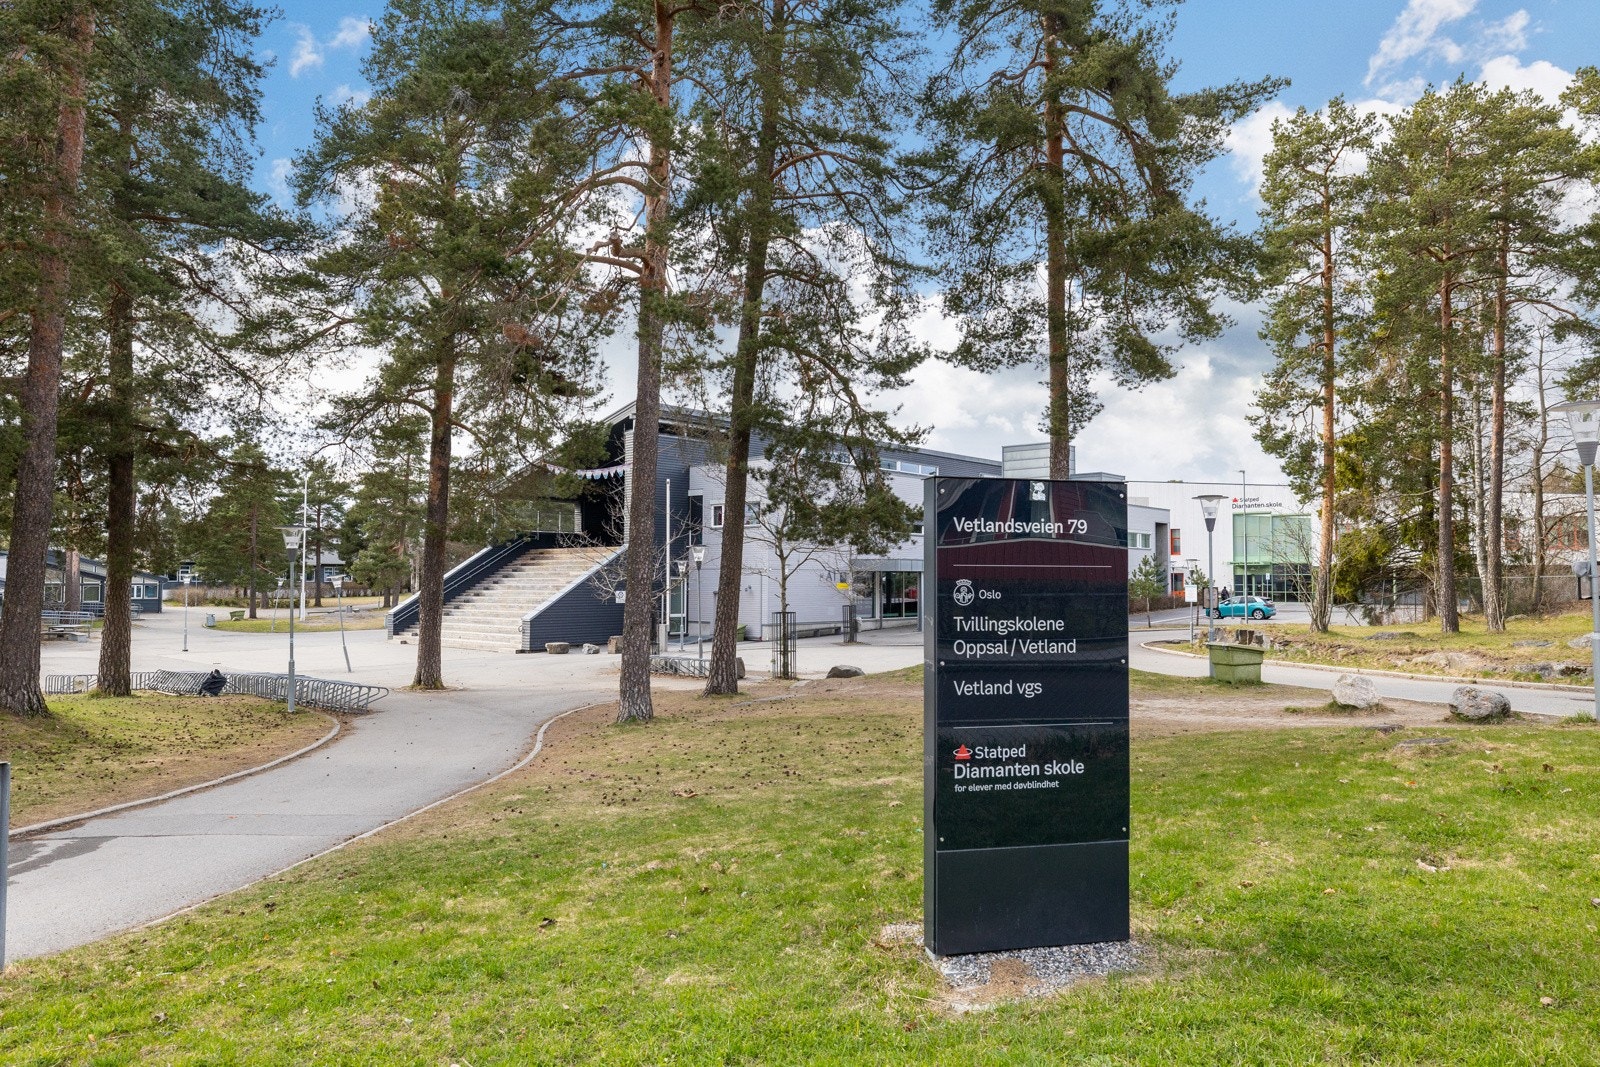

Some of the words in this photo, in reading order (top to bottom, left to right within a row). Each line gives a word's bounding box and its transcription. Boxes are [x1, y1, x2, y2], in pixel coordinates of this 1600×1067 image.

[953, 516, 1063, 534] Vetlandsveien
[1067, 519, 1088, 534] 79
[978, 590, 1002, 600] Oslo
[953, 616, 1065, 635] Tvillingskolene
[953, 639, 1009, 658] Oppsal
[1018, 638, 1077, 654] Vetland
[953, 680, 1013, 696] Vetland
[1016, 682, 1043, 698] vgs
[974, 744, 1026, 761] Statped
[954, 762, 1040, 779] Diamanten
[1044, 760, 1085, 775] skole
[954, 784, 967, 793] for
[968, 783, 993, 792] elever
[994, 782, 1012, 791] med
[1013, 780, 1060, 790] døvblindhet
